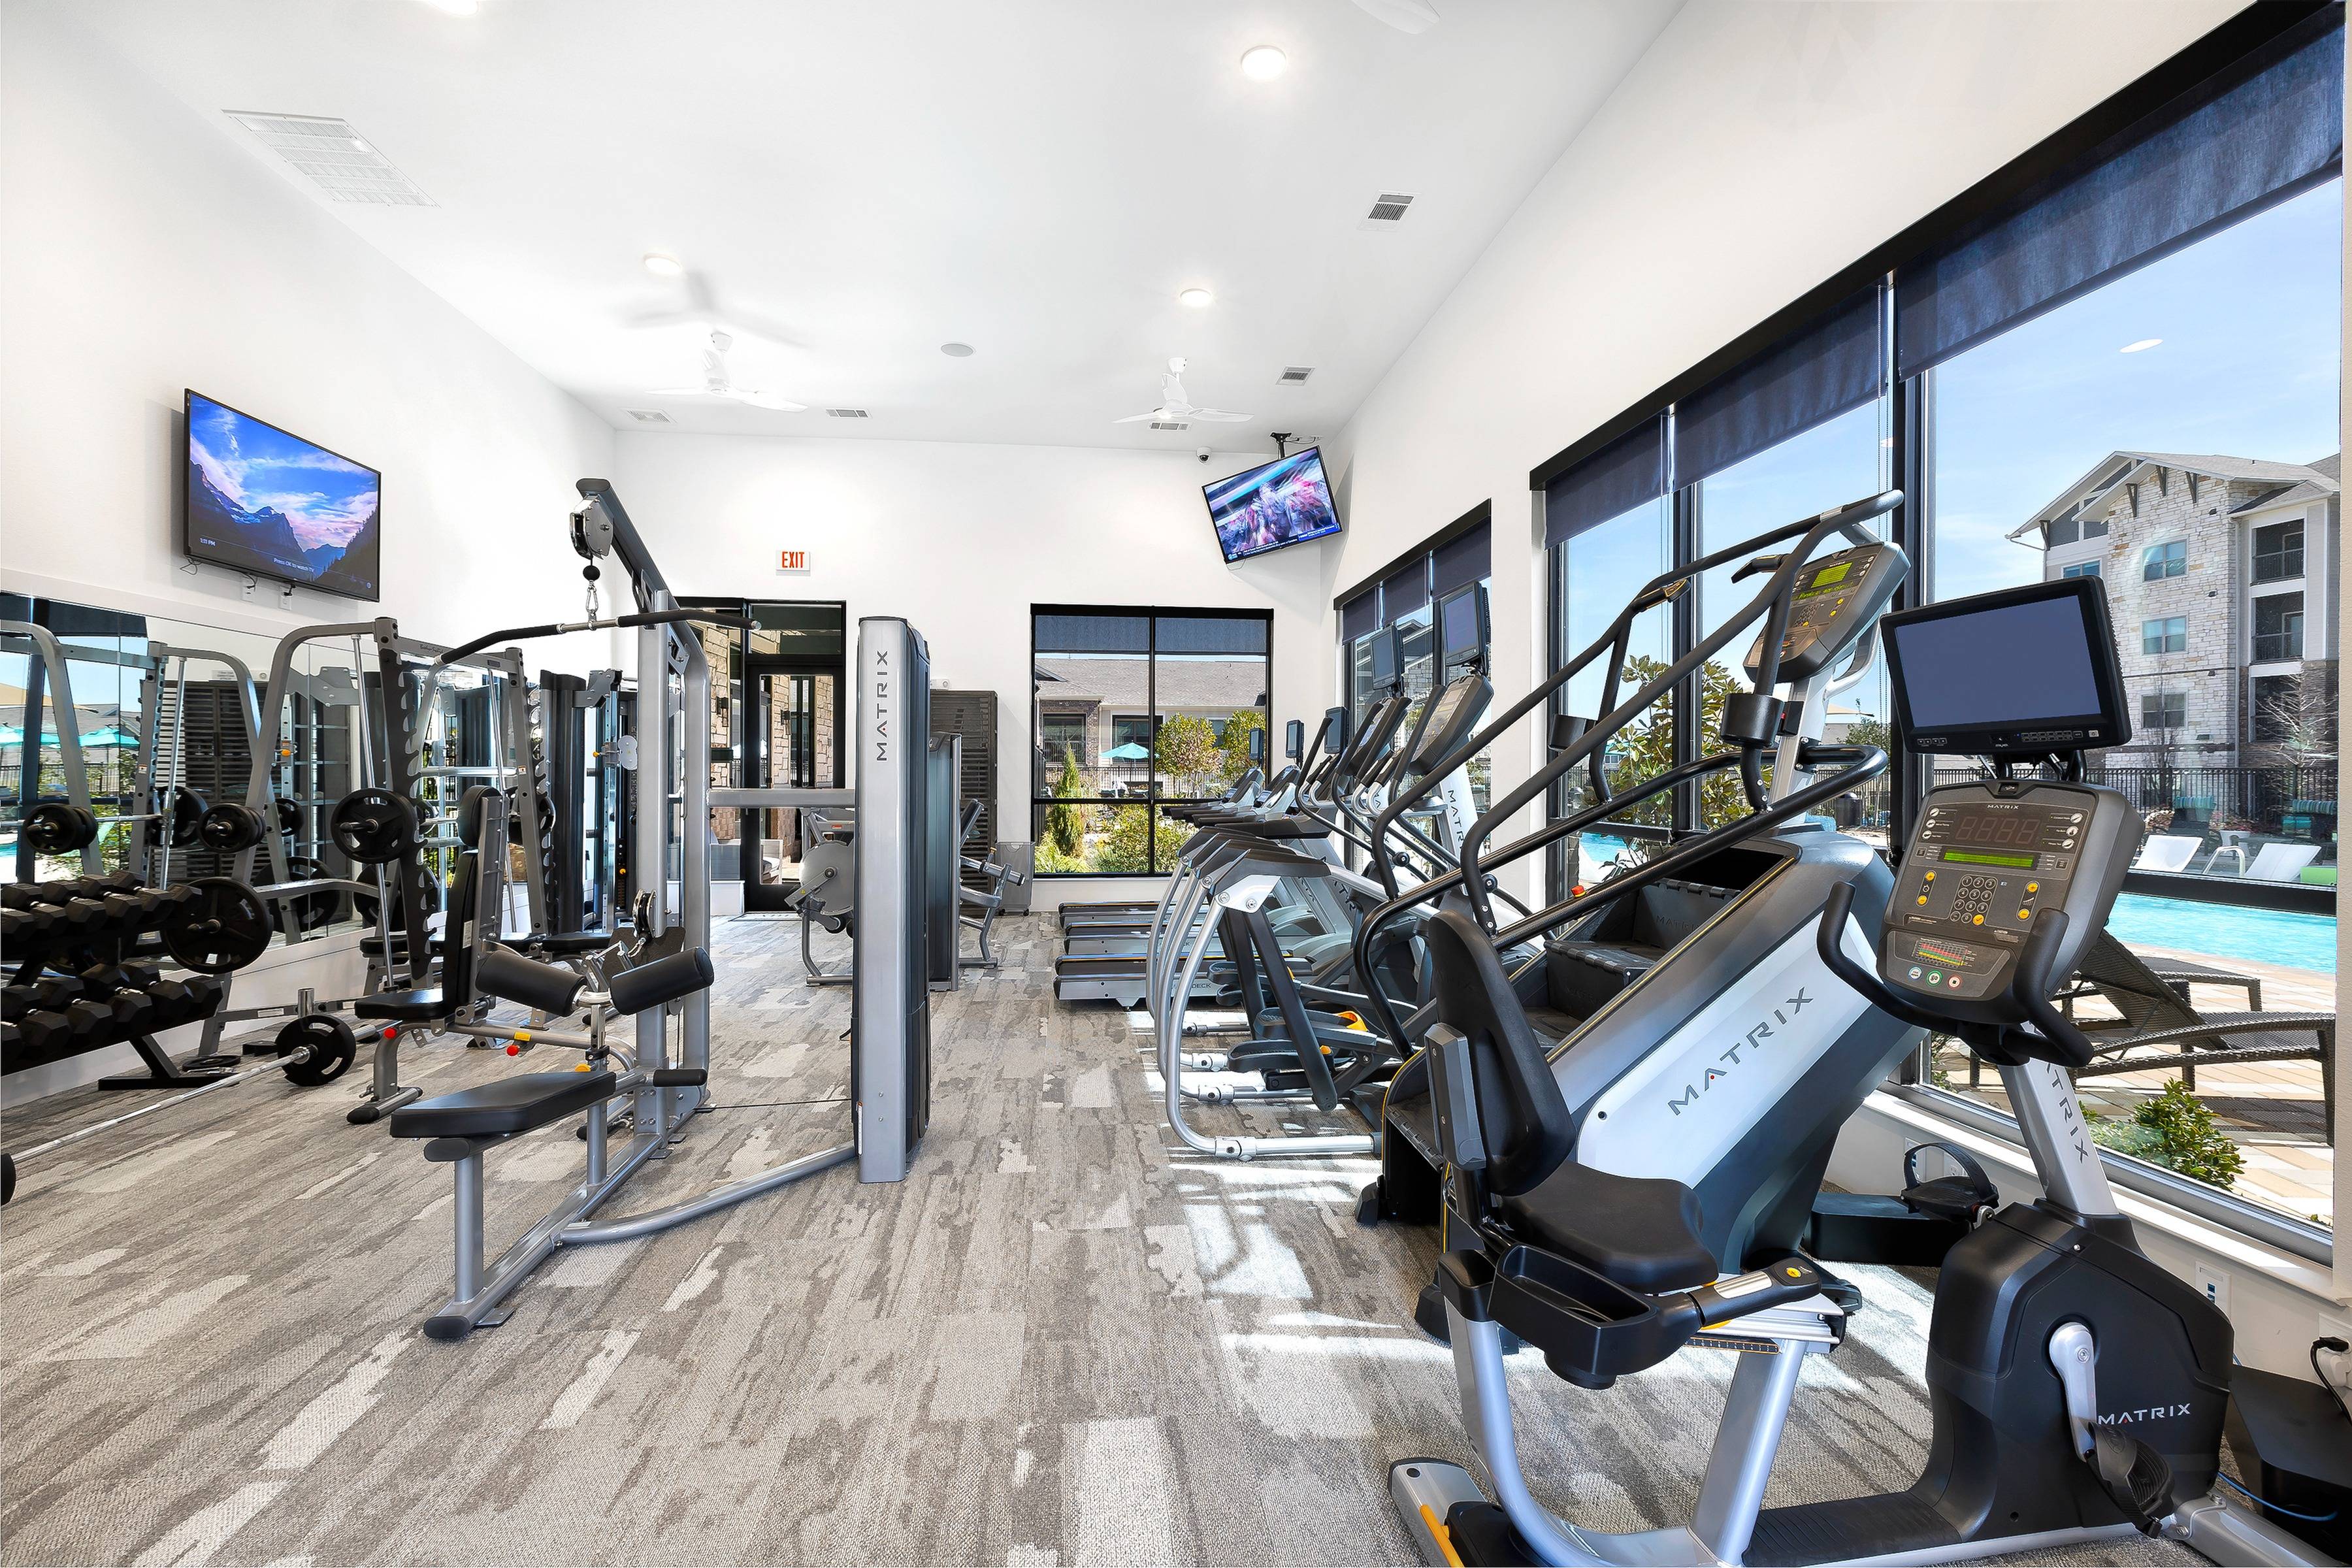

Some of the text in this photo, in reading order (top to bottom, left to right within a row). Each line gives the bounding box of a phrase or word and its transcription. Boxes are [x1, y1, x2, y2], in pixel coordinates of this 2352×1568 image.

[782, 551, 805, 568] EXIT
[876, 650, 888, 761] MATRIX
[1667, 987, 1814, 1116] MATRIX
[2046, 1063, 2089, 1164] TRIX
[2098, 1403, 2191, 1426] MATRIX
